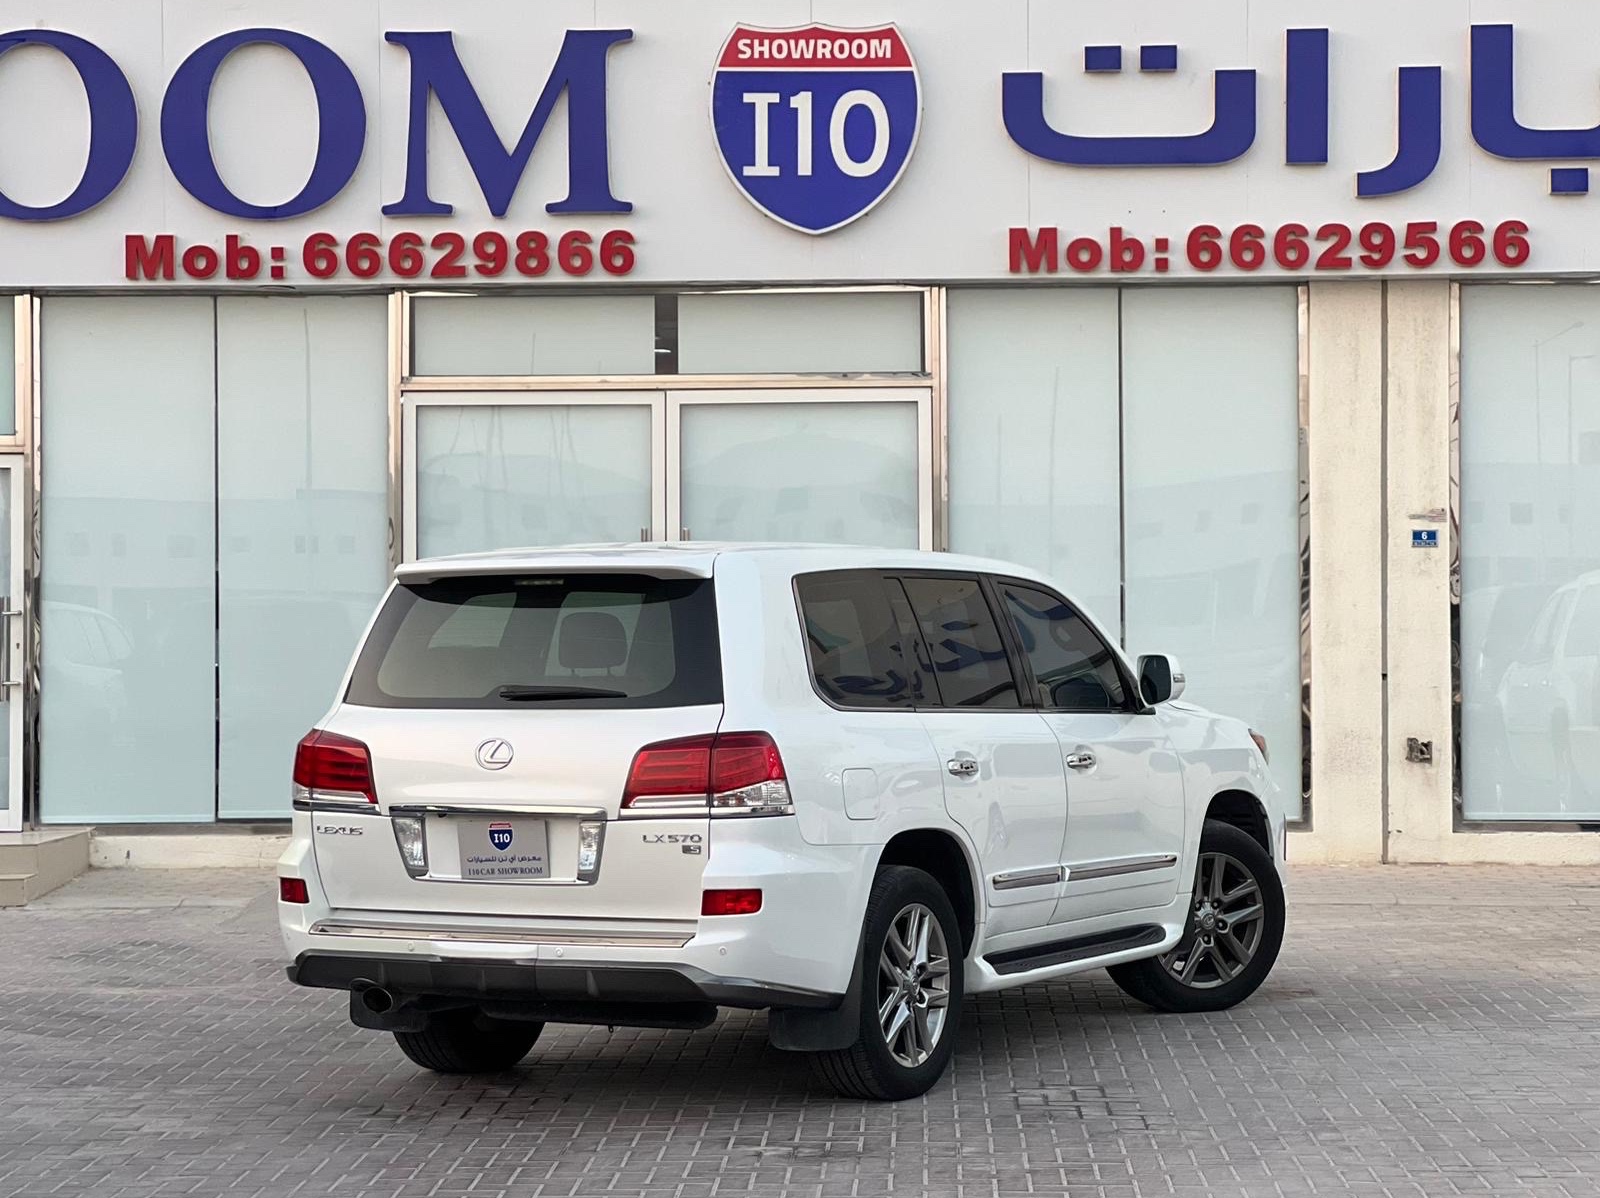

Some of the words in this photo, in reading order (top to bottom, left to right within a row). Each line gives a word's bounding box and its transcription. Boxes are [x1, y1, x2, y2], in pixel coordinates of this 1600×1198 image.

[737, 38, 892, 59] SHOWROOM
[742, 89, 890, 178] I10
[1008, 226, 1171, 273] Mob:
[1185, 220, 1530, 270] 66629566
[124, 234, 286, 280] Mob:
[302, 230, 636, 277] 66629866
[1421, 531, 1428, 540] 6
[316, 825, 363, 836] LEXUS
[493, 833, 510, 843] I10
[642, 834, 666, 844] LX
[667, 834, 703, 844] 570
[480, 867, 496, 876] CAR
[497, 866, 543, 875] SHOWROOM
